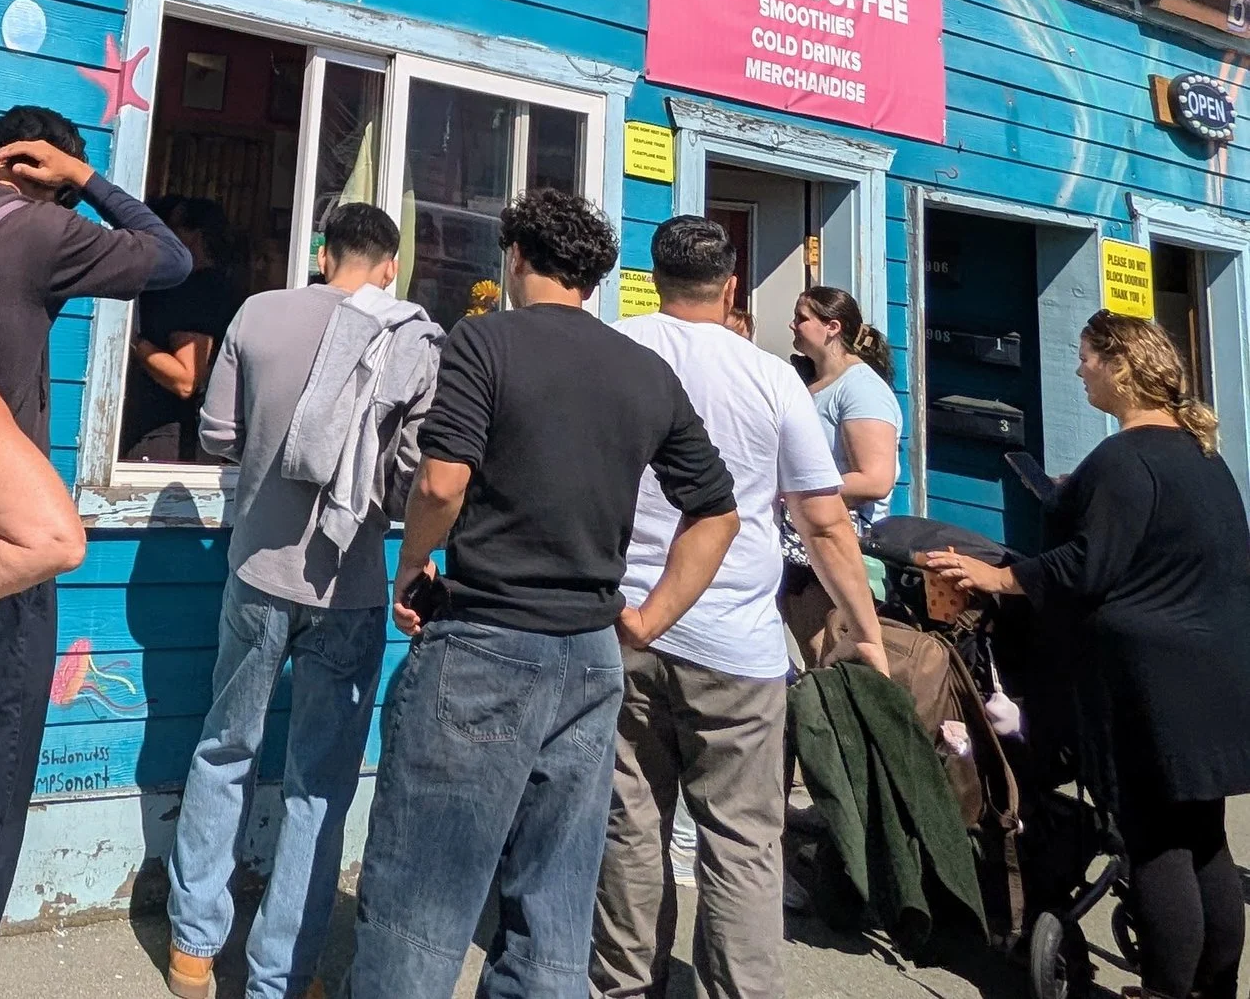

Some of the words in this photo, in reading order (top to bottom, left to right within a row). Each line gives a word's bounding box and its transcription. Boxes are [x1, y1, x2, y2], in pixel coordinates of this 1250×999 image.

[751, 27, 798, 57] COLD
[801, 39, 862, 72] DRINKS
[745, 57, 866, 104] MERCHANDISE
[1187, 91, 1226, 123] OPEN
[1107, 254, 1127, 268] PLEASE
[1128, 258, 1136, 270] DO
[1136, 260, 1146, 272] NOT
[620, 272, 647, 282] WELCOM
[1106, 270, 1123, 283] BLOCK
[1124, 273, 1149, 288] DOORWAY
[1111, 287, 1129, 301] THANK
[1129, 291, 1140, 302] YOU
[995, 338, 1002, 351] 1
[1000, 419, 1010, 432] 3
[41, 744, 110, 765] Shdonutss
